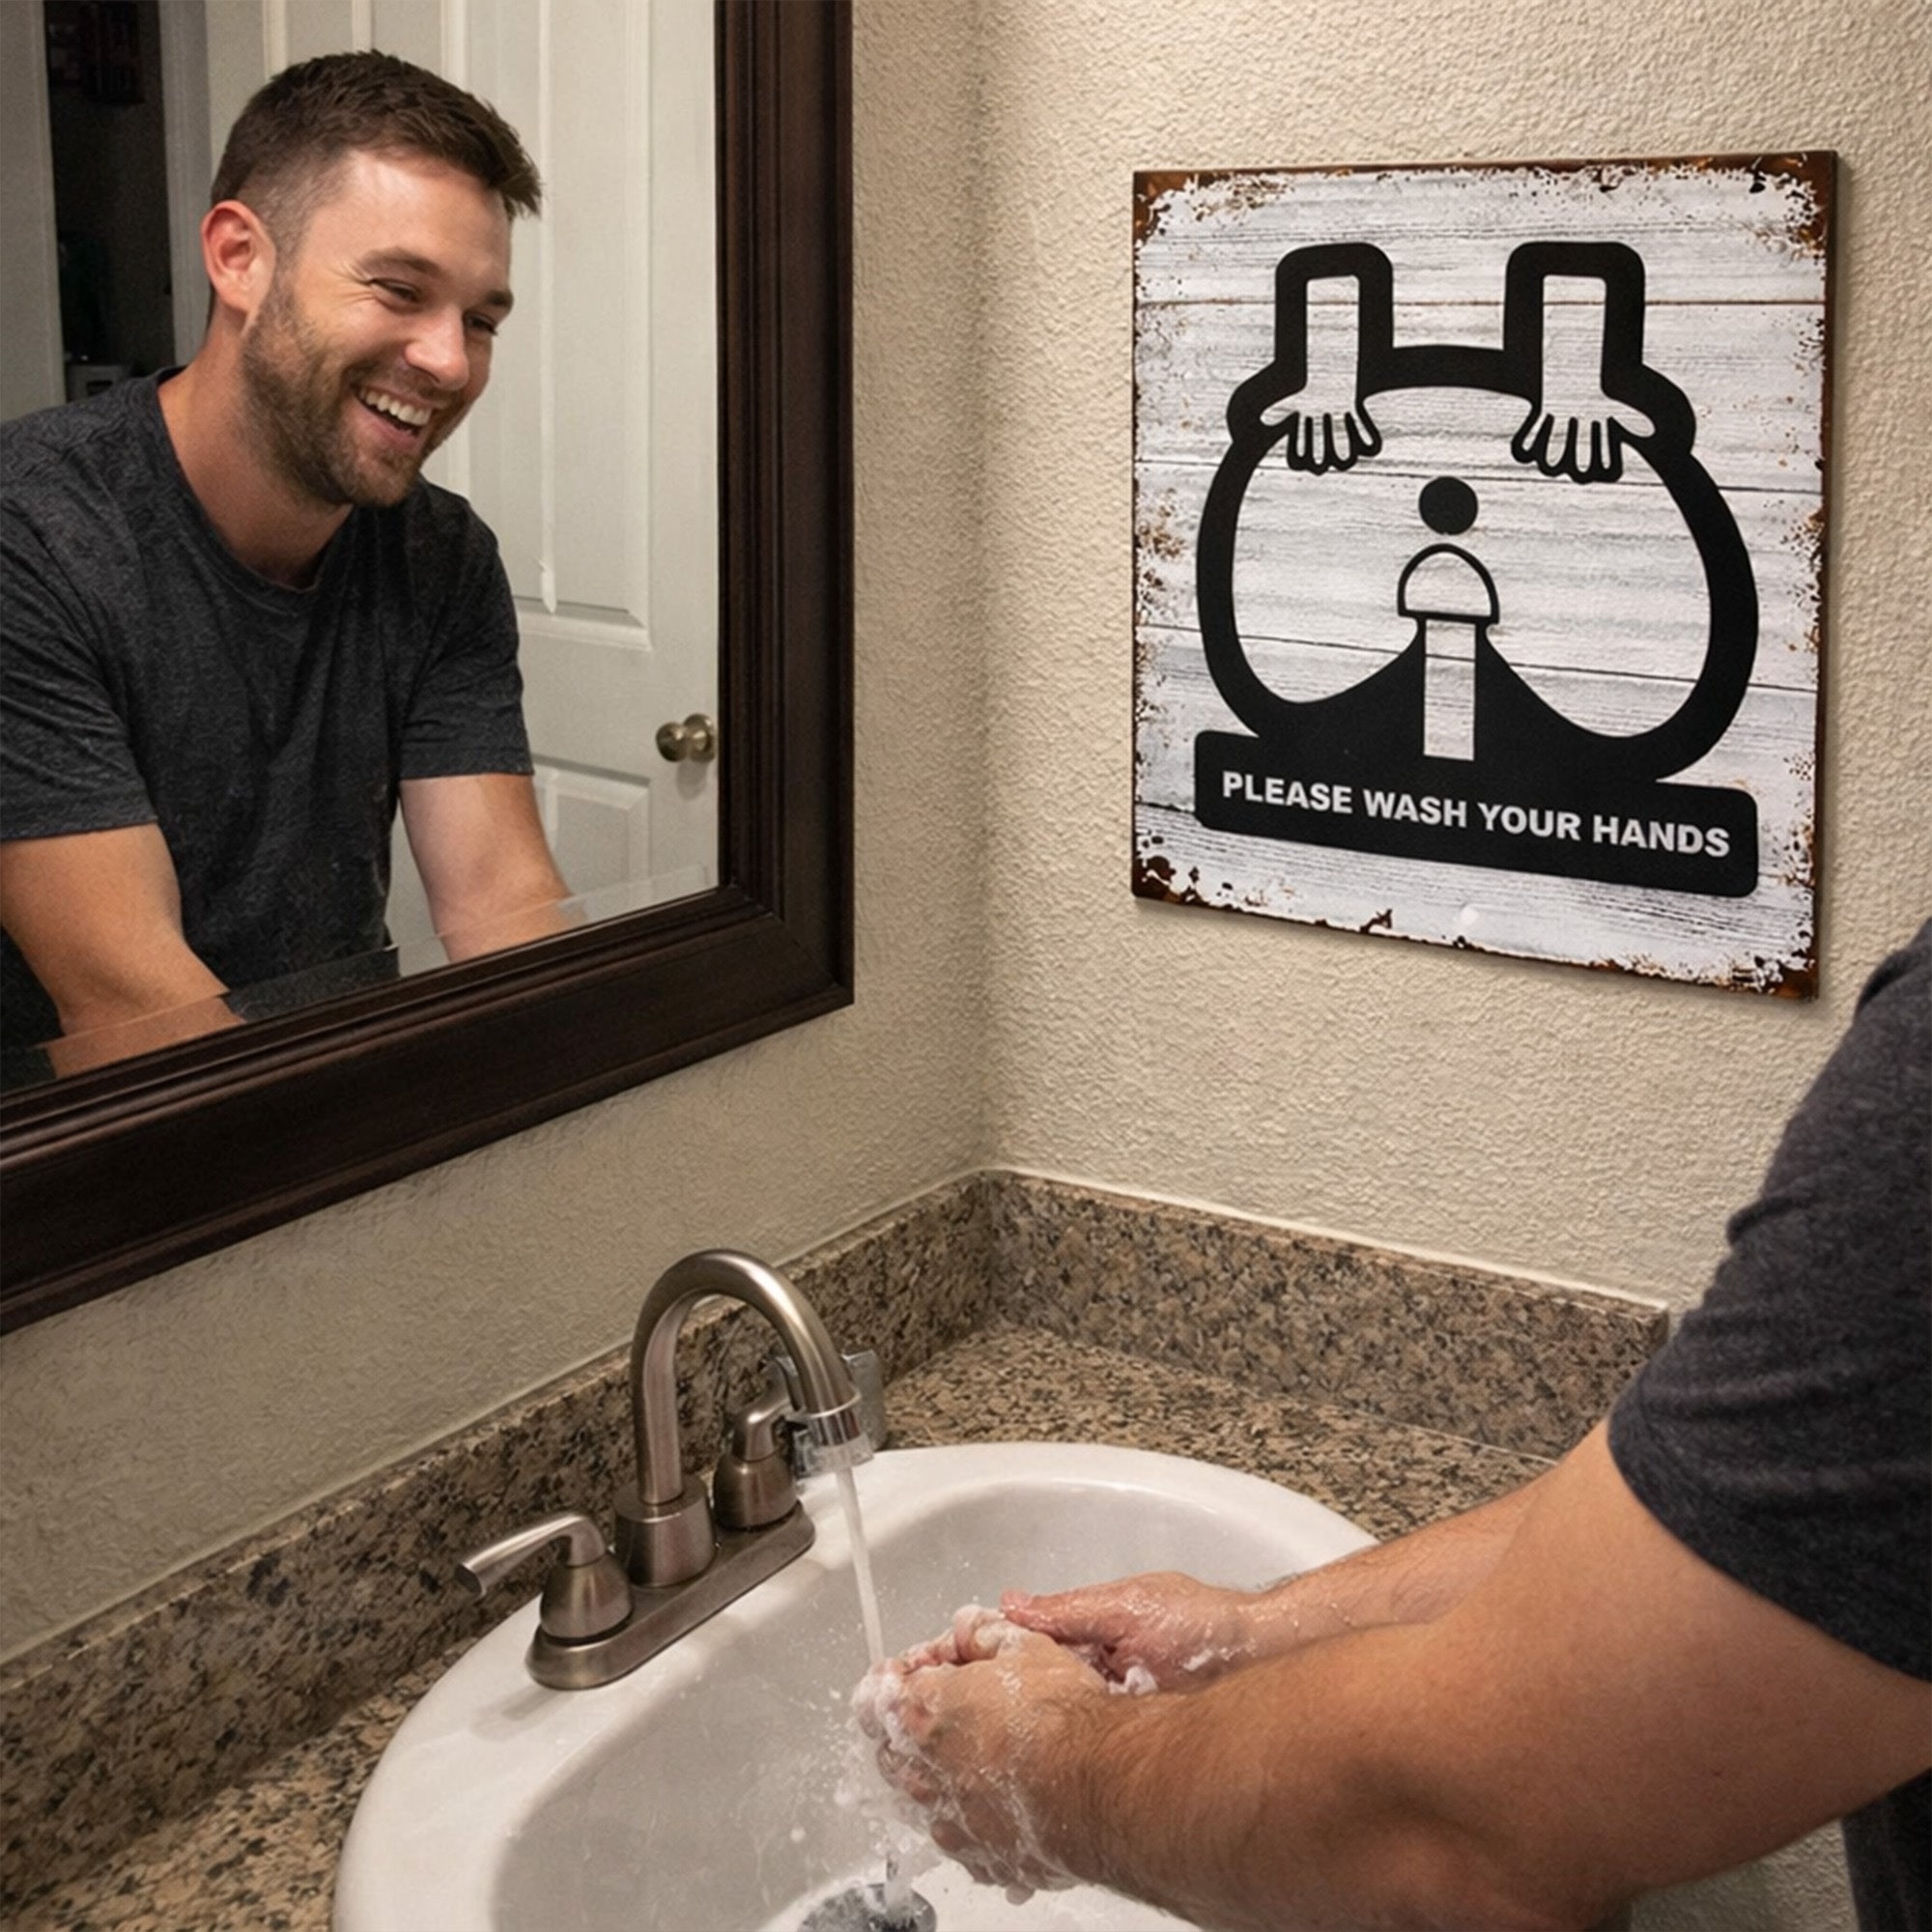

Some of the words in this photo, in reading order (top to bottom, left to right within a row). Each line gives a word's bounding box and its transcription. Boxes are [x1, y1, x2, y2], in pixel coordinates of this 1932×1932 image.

[1223, 771, 1352, 813] PLEASE
[1363, 789, 1466, 828] WASH
[1477, 802, 1581, 841] YOUR
[1593, 814, 1730, 857] HANDS
